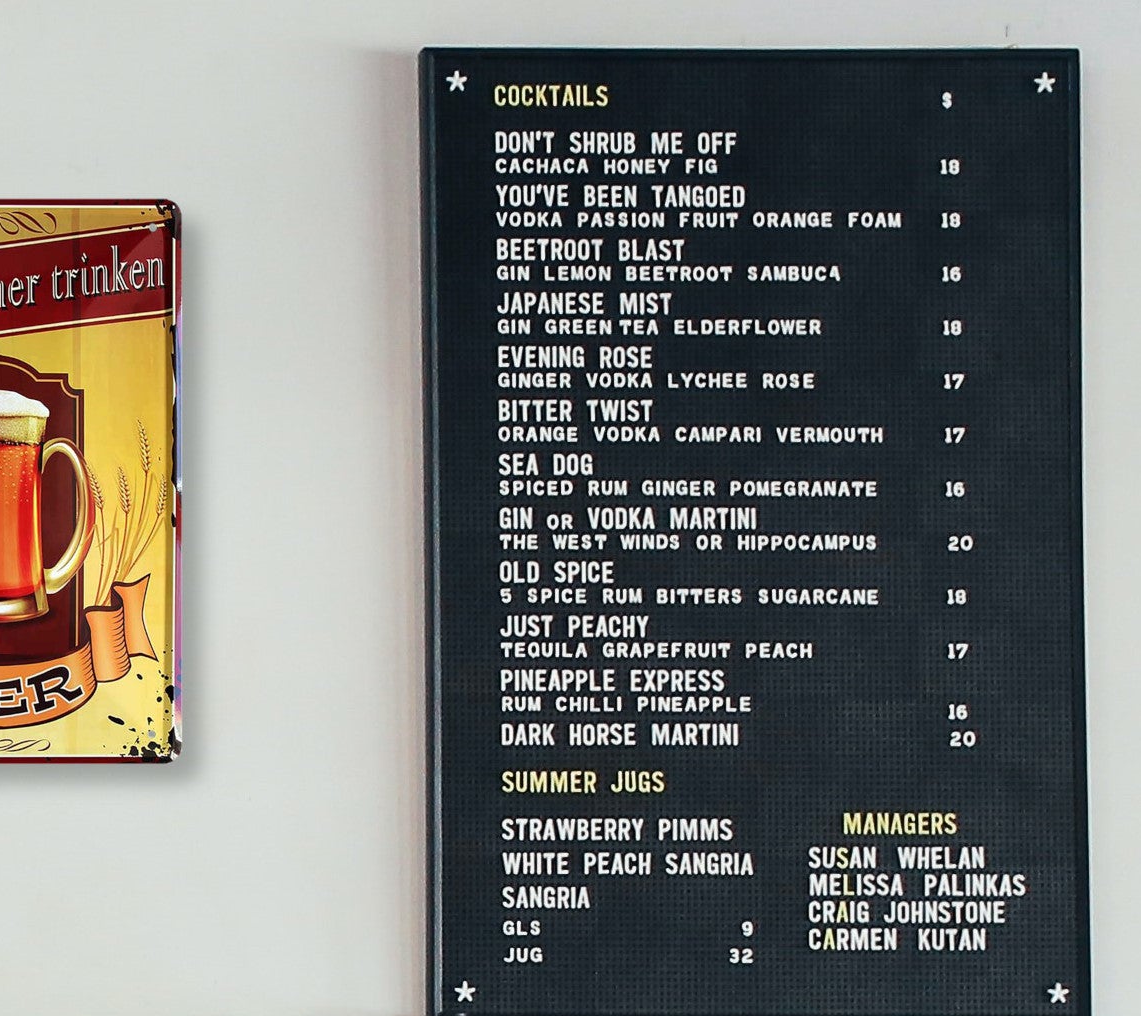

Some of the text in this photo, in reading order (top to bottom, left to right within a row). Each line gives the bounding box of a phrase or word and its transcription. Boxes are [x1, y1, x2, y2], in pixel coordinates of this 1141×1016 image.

[494, 84, 609, 107] COCKTAILS
[494, 130, 737, 155] DON'T SHRUB ME OFF
[495, 157, 960, 175] CACHACA HONEY FIG 18
[495, 183, 746, 208] YOU'VE BEEN TANGOED
[495, 211, 961, 229] VODKA PASSION FRUIT ORANGE FOAM 18
[496, 238, 685, 262] BEETROOT BLAST
[50, 244, 166, 303] trinken
[496, 265, 530, 282] GIN
[544, 265, 612, 282] LEMON
[625, 265, 733, 282] BEETROOT
[941, 266, 962, 283] 16
[496, 291, 672, 316] JAPANESE MIST
[497, 318, 962, 336] GIN GREEN TEA ELDERFLOWER 18
[497, 345, 653, 370] EVENING ROSE
[497, 372, 965, 390] GINGER VODKA LYCHEE ROSE 17
[498, 399, 653, 423] BITTER TWIST
[497, 425, 966, 444] ORANGE VODKA CAMPARI VERMOUTH 17
[498, 453, 594, 476] SEA DOG
[499, 479, 965, 498] SPICED RUM GINGER POMEGRANATE 16
[499, 506, 757, 531] GIN OR VODKA MARTINI
[499, 533, 974, 552] THE WEST WINDS OR HIPPOCAMPUS 20
[499, 560, 614, 584] OLD SPICE
[499, 587, 967, 606] 5 SPICE RUM BITTERS SUGARCANE 18
[499, 614, 649, 638] JUST PEACHY
[500, 641, 969, 660] TEQUILA GRAPEFRUIT PEACH 17
[500, 668, 725, 693] PINEAPPLE EXPRESS
[501, 695, 968, 721] RUM CHILLI PINEAPPLE 16
[501, 722, 977, 748] DARK HORSE MARTINI 20
[501, 770, 665, 794] SUMMER JUGS
[501, 817, 733, 842] STRAWBERRY PIMMS
[843, 812, 958, 836] MANAGERS
[502, 851, 754, 876] WHITE PEACH SANGRIA
[808, 846, 985, 870] SUSAN WHELAN
[809, 873, 1027, 897] MELISSA PALINKAS
[502, 885, 591, 910] SANGRIA
[808, 900, 1006, 924] CRAIG JOHNSTONE
[502, 920, 754, 937] GLS 9
[808, 927, 986, 952] CARMEN KUTAN
[503, 946, 754, 964] JUG 32
